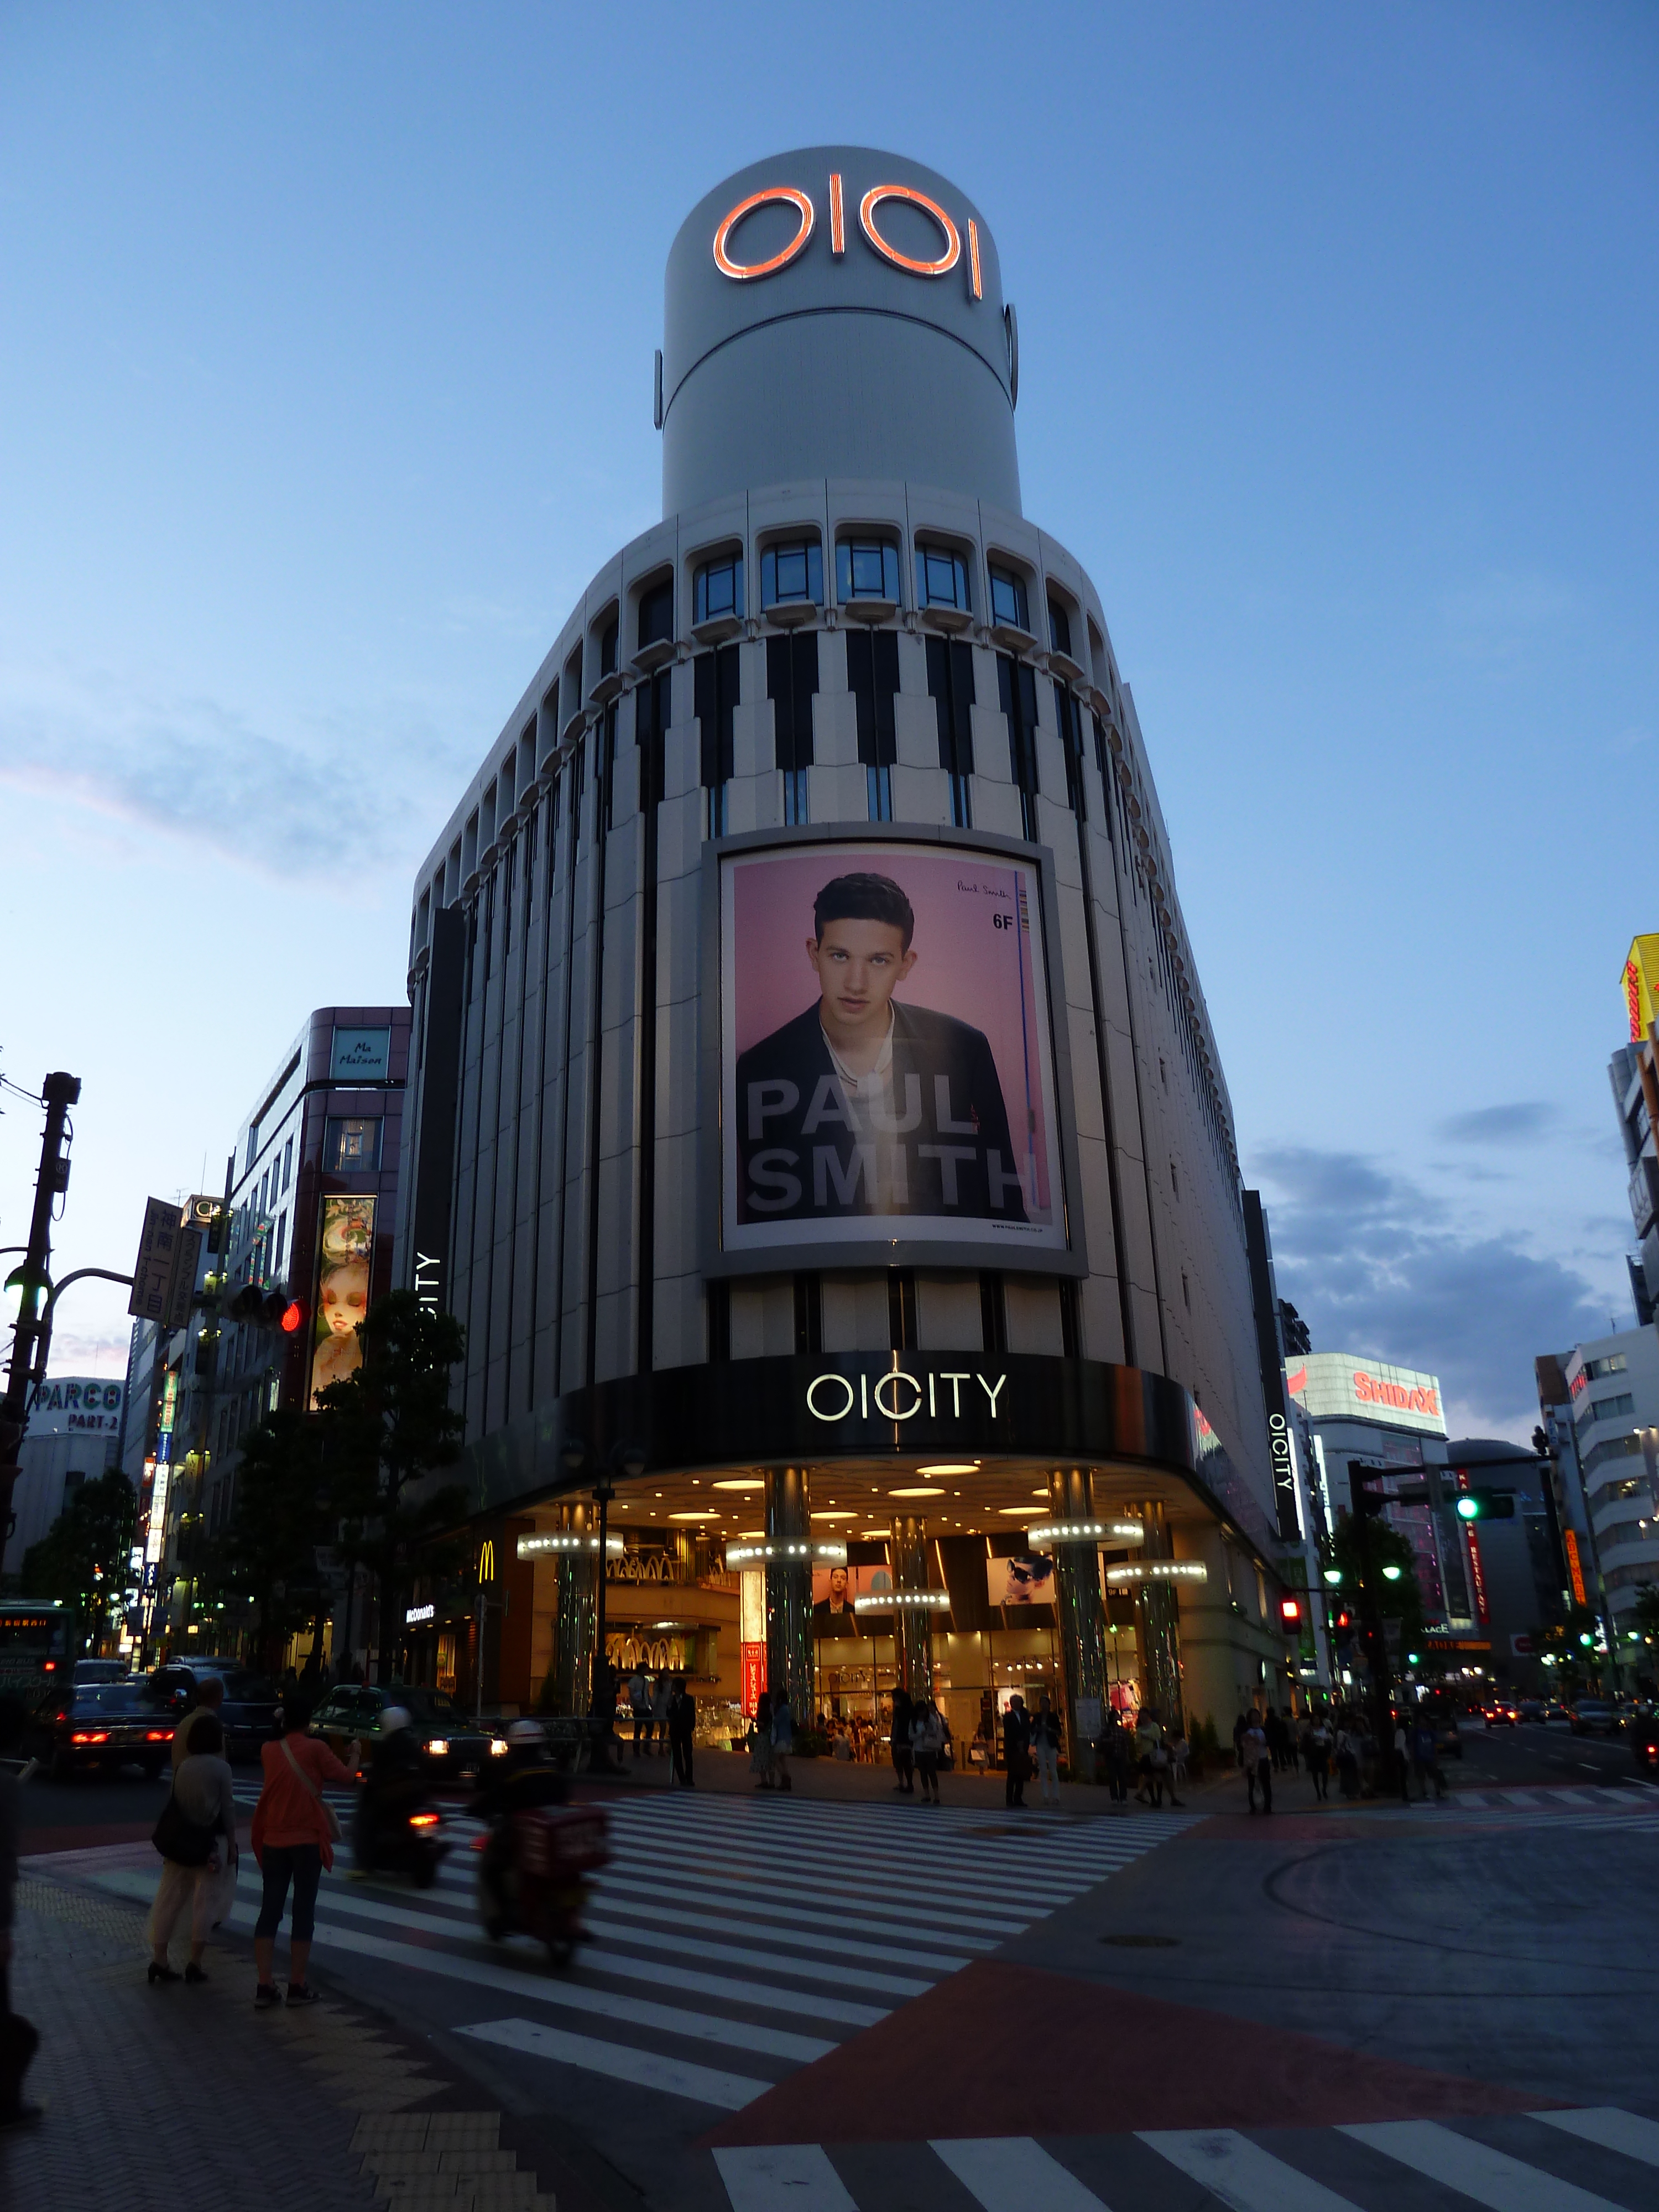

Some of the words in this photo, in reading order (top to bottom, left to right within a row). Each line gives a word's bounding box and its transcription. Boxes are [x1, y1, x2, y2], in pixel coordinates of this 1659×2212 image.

[993, 914, 1014, 931] 6F
[339, 1055, 382, 1065] Maison
[354, 1042, 372, 1053] Ma
[748, 1072, 978, 1140] PAUL
[746, 1144, 1040, 1214] SMITH
[147, 1208, 177, 1313] 神南一丁目
[35, 1383, 121, 1411] PARCO
[1353, 1371, 1439, 1416] SHIDAX
[1269, 1413, 1293, 1491] OICITY
[406, 1604, 434, 1624] McDonald's
